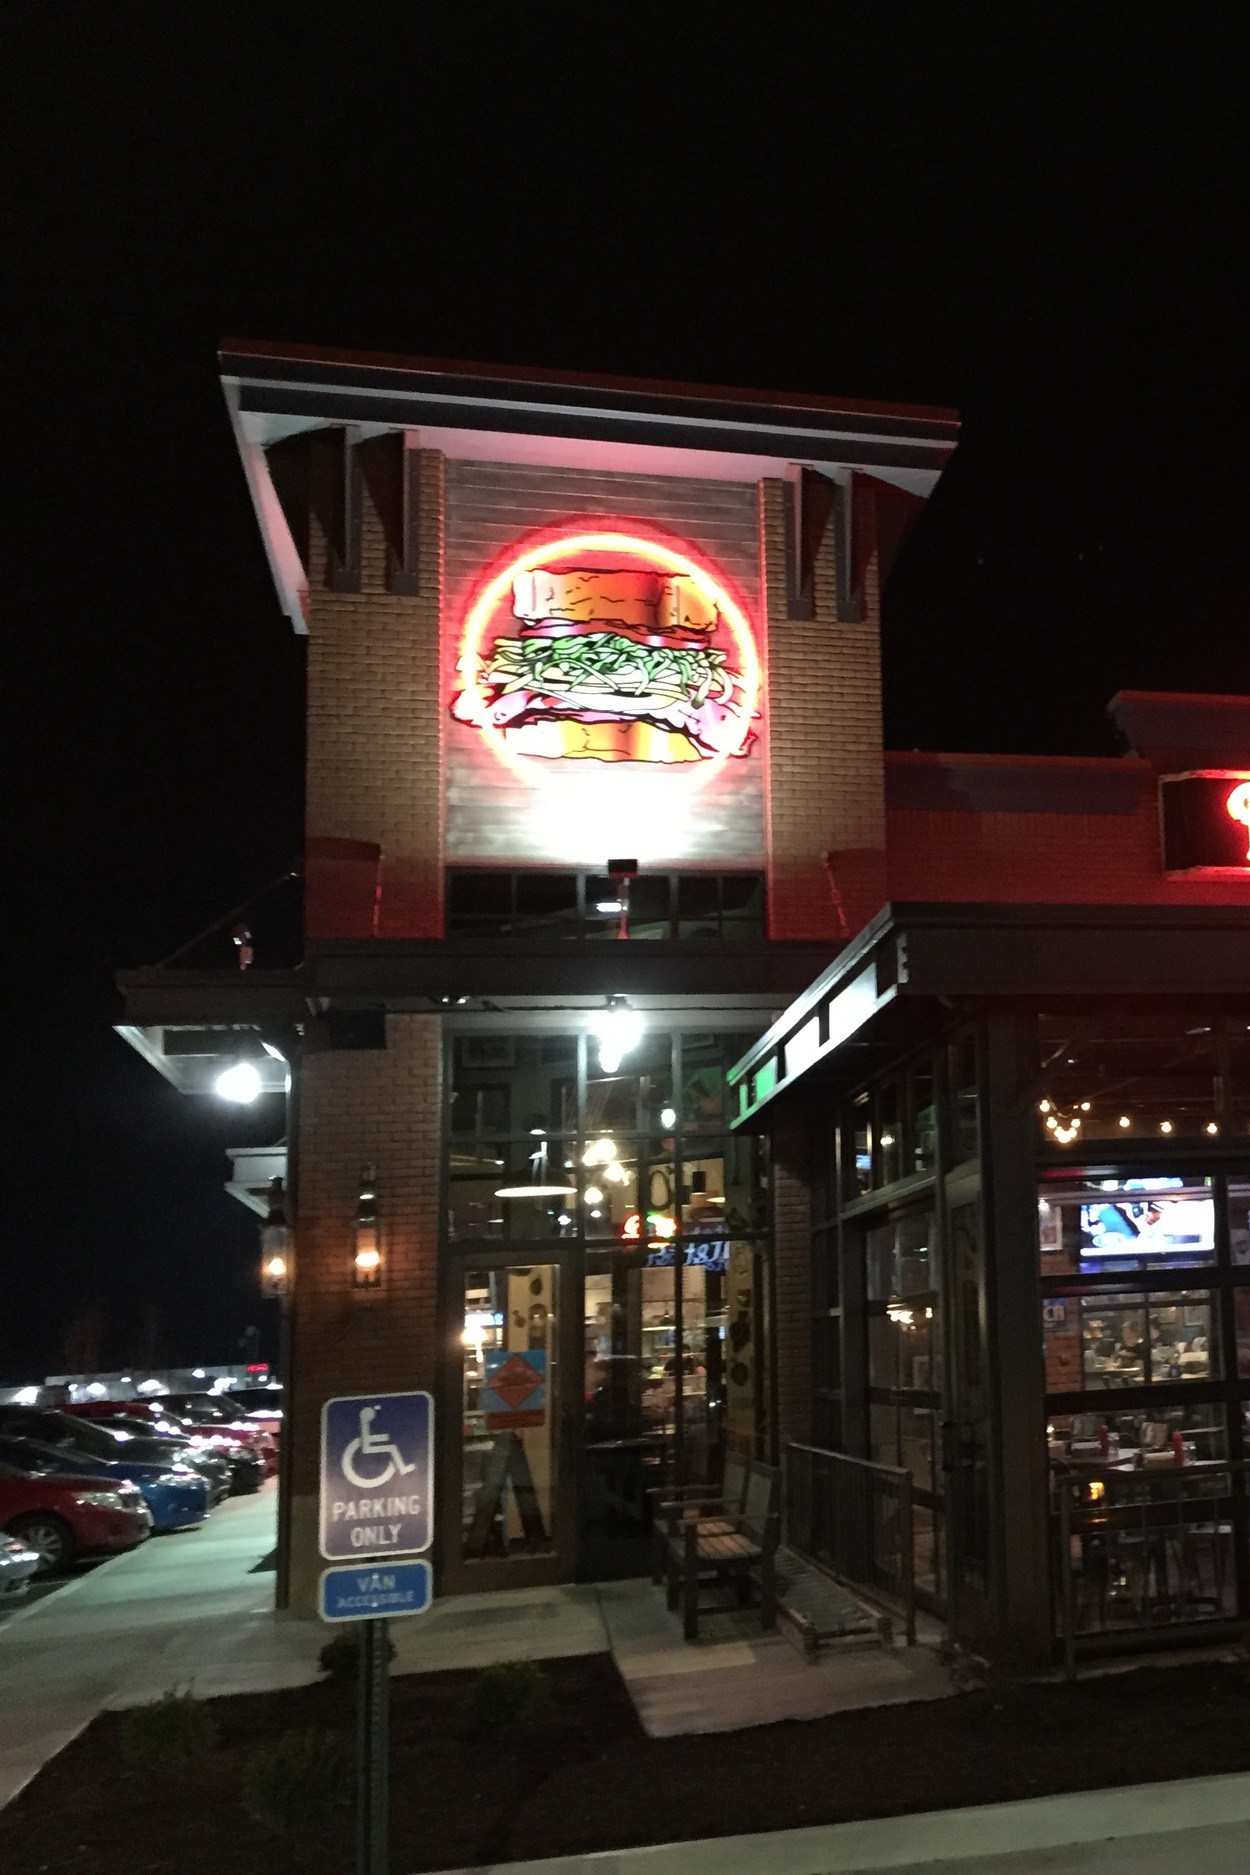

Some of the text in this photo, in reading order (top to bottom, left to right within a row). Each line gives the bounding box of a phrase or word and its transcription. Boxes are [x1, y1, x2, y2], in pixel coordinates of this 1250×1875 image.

[332, 1495, 420, 1521] PARKING
[351, 1524, 401, 1547] ONLY
[356, 1573, 396, 1593] VAN
